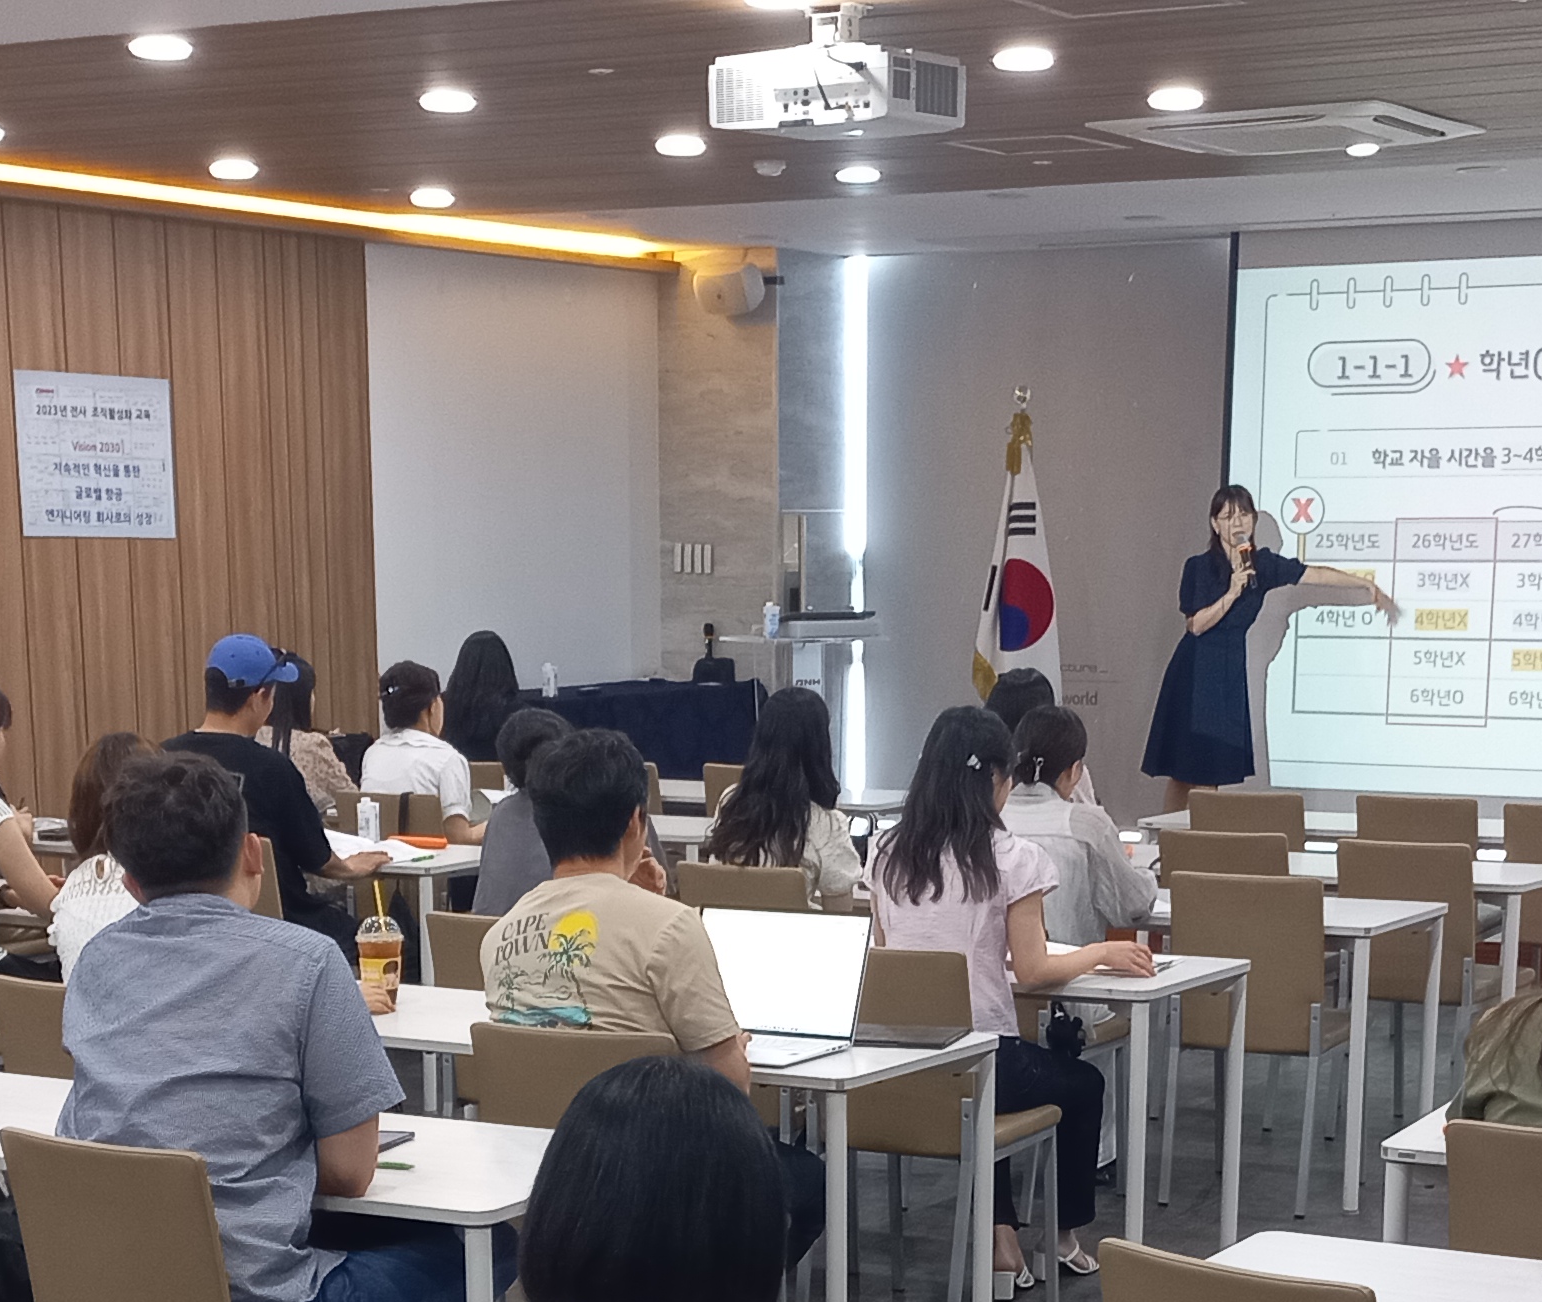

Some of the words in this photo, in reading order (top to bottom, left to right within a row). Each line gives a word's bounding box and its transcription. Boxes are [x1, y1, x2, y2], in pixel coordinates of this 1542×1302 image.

[1336, 354, 1414, 380] 1-1-1
[36, 404, 67, 418] 2023년
[99, 441, 120, 453] 2030
[1330, 451, 1348, 466] 01
[1372, 447, 1405, 468] 학교
[1408, 447, 1442, 468] 자율
[1446, 446, 1497, 468] 시간을
[93, 462, 120, 478] 혁신을
[75, 485, 102, 501] 글로벌
[1315, 533, 1380, 551] 25학년도
[1411, 533, 1479, 550] 26학년도
[1416, 571, 1470, 590] 3학년X
[1315, 609, 1355, 629] 4학년
[1415, 610, 1469, 630] 4학년X
[1412, 649, 1466, 668] 5학년X
[1410, 688, 1464, 708] 6학년O
[501, 911, 550, 942] CAPE
[494, 931, 553, 966] TOWN
